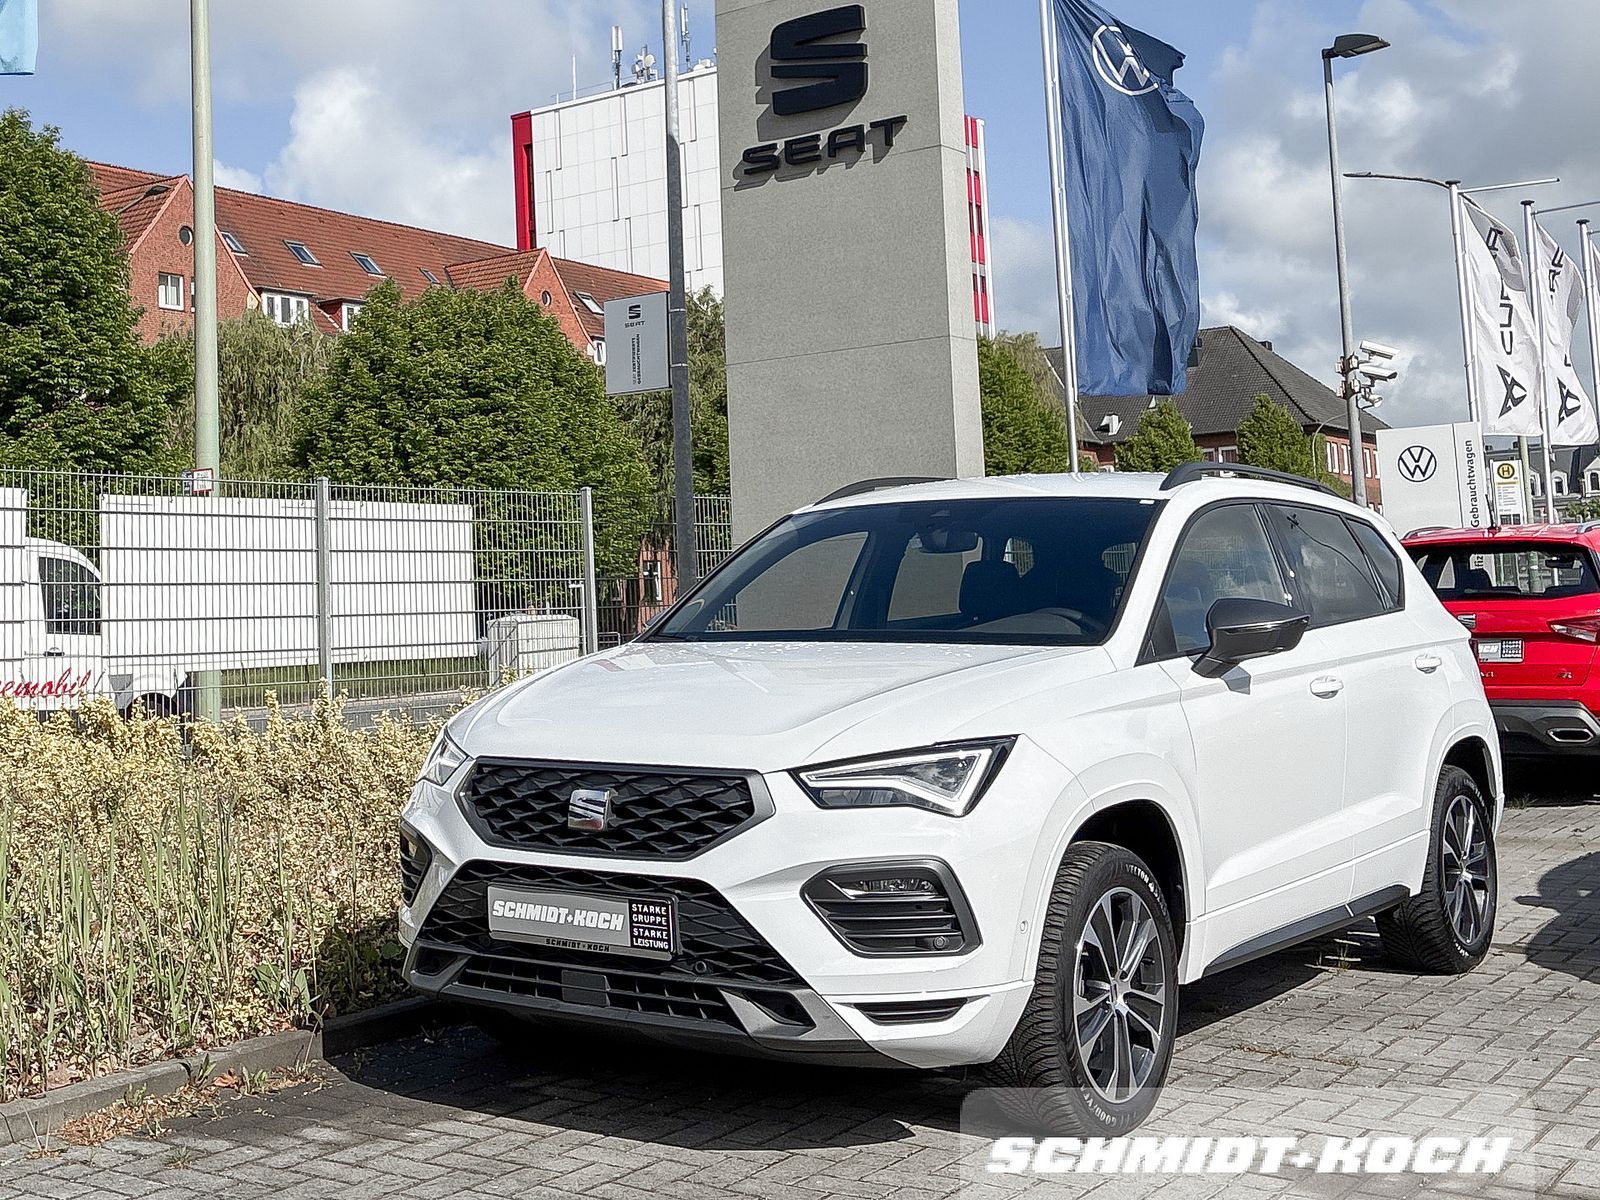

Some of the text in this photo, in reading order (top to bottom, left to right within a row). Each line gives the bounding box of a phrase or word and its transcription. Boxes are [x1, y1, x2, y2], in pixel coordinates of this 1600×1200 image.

[742, 115, 908, 176] SEAT
[1465, 439, 1480, 528] Gebrauchtwagen
[0, 667, 92, 698] emobil
[492, 900, 625, 931] SCHMIDT+KOCH
[632, 903, 667, 915] STARKE
[632, 914, 667, 926] GRUPPE
[633, 927, 668, 940] STARKE
[545, 938, 581, 948] SCHMIDT
[587, 943, 610, 952] KOCH
[633, 937, 669, 950] LEISTUNG
